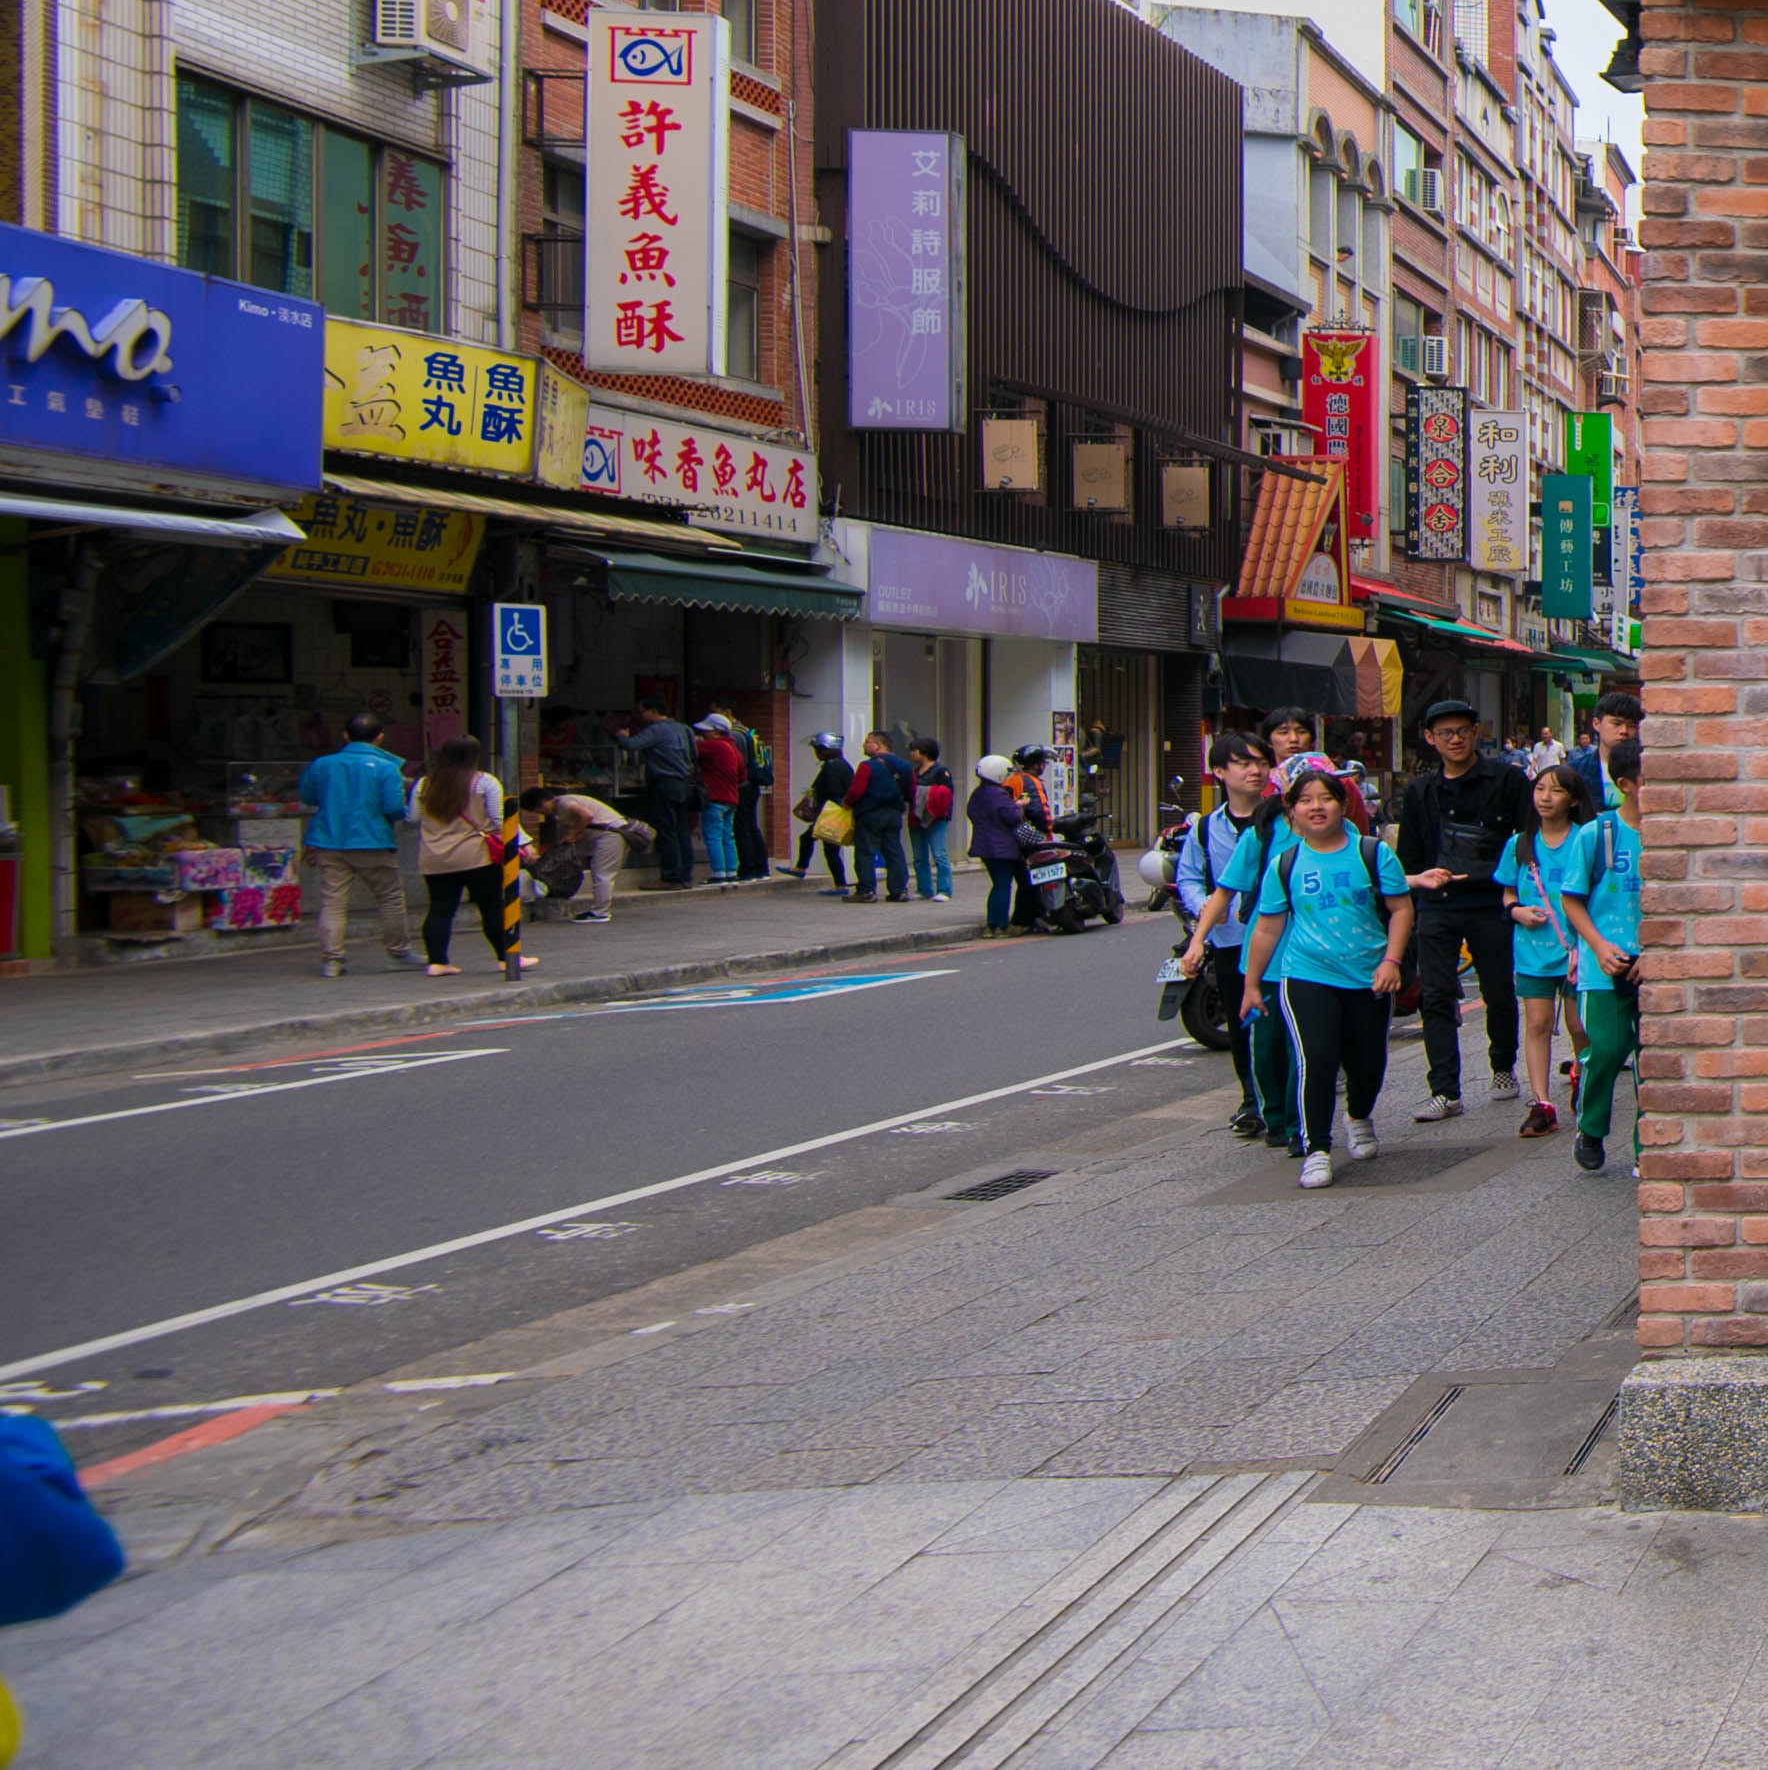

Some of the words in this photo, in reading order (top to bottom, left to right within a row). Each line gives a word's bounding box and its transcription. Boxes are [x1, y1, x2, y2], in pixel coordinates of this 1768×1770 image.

[617, 100, 685, 354] 許義魚酥
[911, 150, 942, 335] 艾莉詩服飾
[238, 298, 270, 319] Kimo
[419, 351, 467, 437] 魚丸
[480, 363, 536, 445] 魚酥
[895, 397, 937, 417] IRIS
[632, 428, 807, 509] 味香魚丸店
[1427, 414, 1458, 531] 泉合舍
[1478, 419, 1519, 485] 和利
[990, 570, 1028, 607] IRIS
[1559, 518, 1575, 594] 傳藝工坊
[500, 674, 543, 688] 停車位
[1302, 870, 1322, 895] 5
